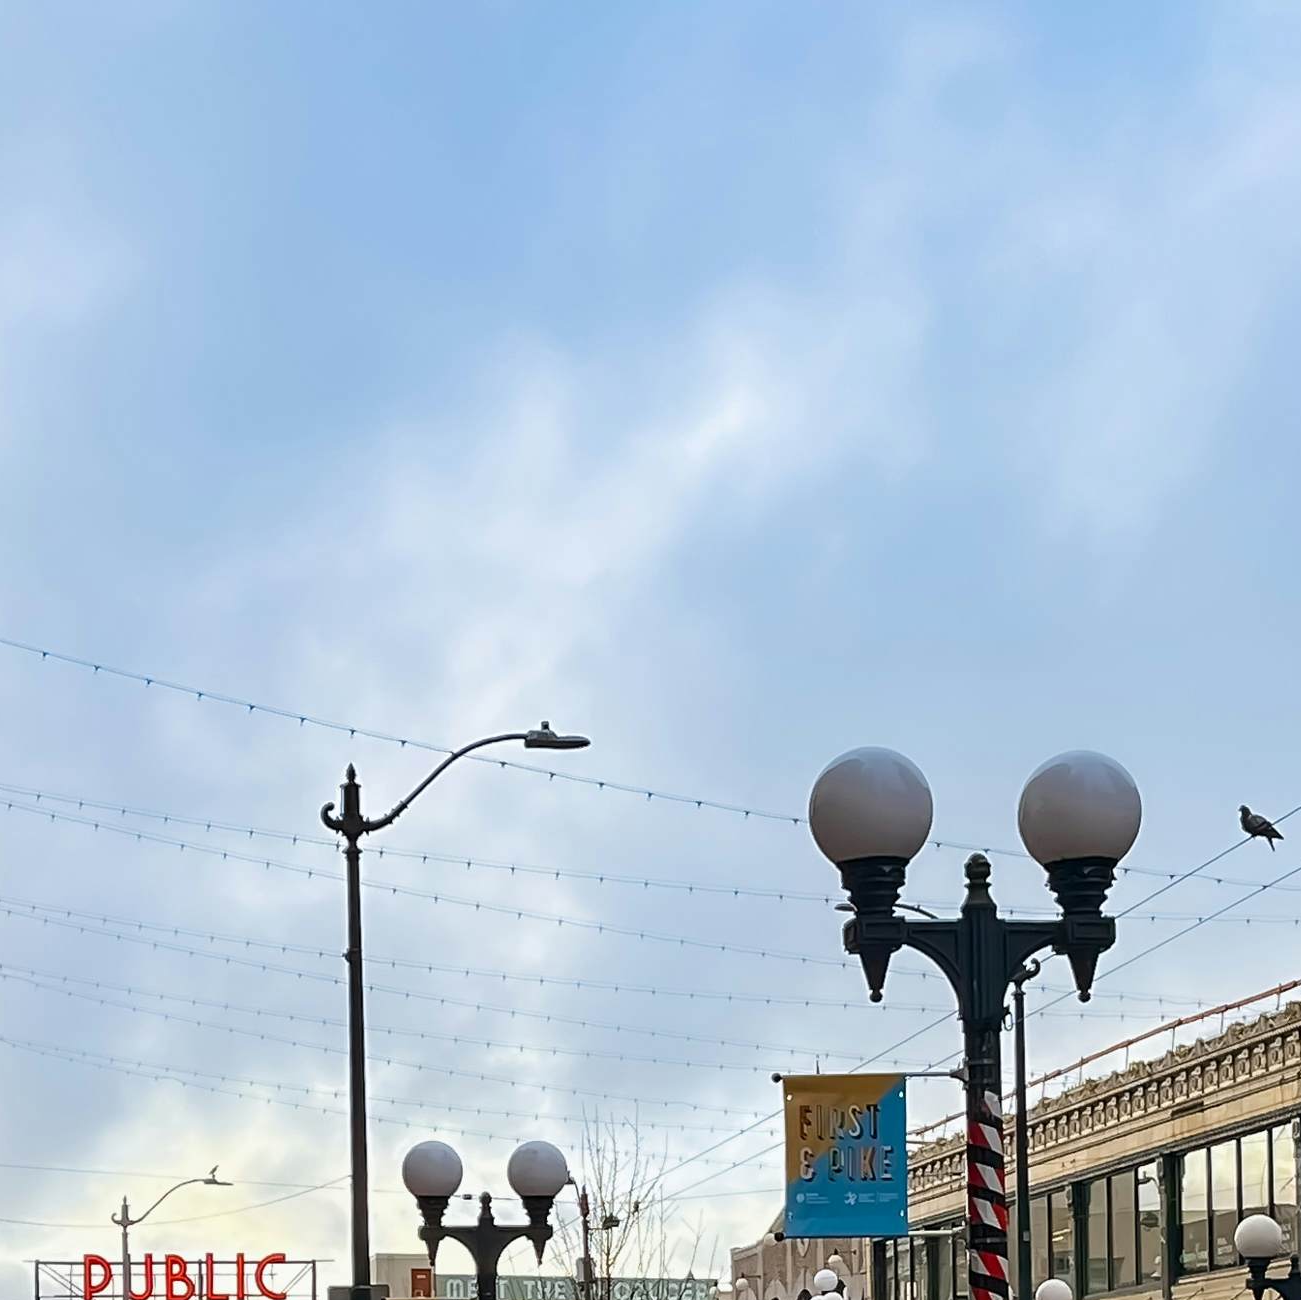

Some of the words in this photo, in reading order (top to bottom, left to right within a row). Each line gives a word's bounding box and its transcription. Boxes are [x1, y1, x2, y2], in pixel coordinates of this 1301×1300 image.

[799, 1103, 881, 1141] FIRST
[800, 1147, 816, 1182] &
[828, 1145, 894, 1181] PIKE
[446, 1278, 510, 1299] MET
